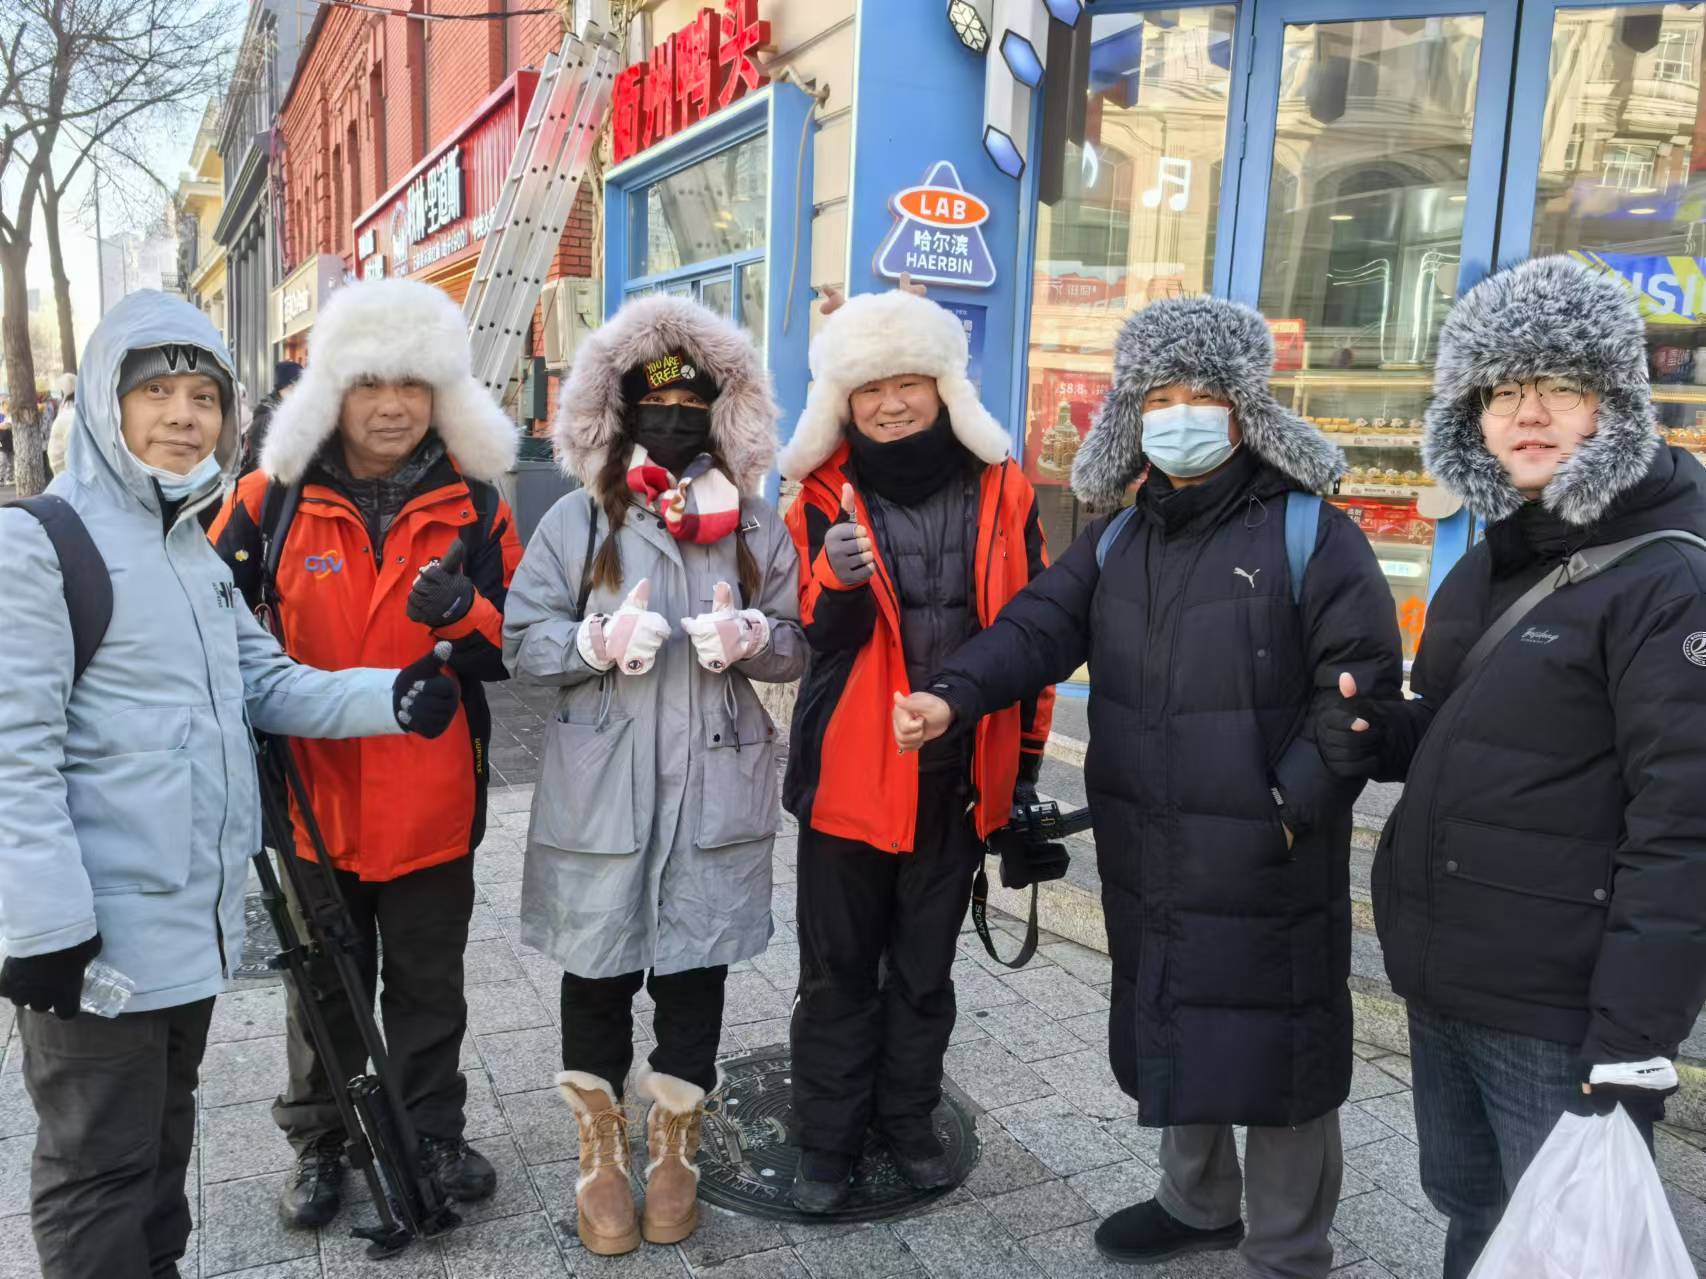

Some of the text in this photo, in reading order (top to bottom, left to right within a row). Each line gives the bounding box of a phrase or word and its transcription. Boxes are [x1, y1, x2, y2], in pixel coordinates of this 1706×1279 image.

[920, 193, 967, 221] LAB
[913, 229, 969, 256] 哈尔滨
[906, 252, 974, 275] HAERBIN
[646, 355, 680, 374] YOU ARE
[650, 366, 681, 386] FREE
